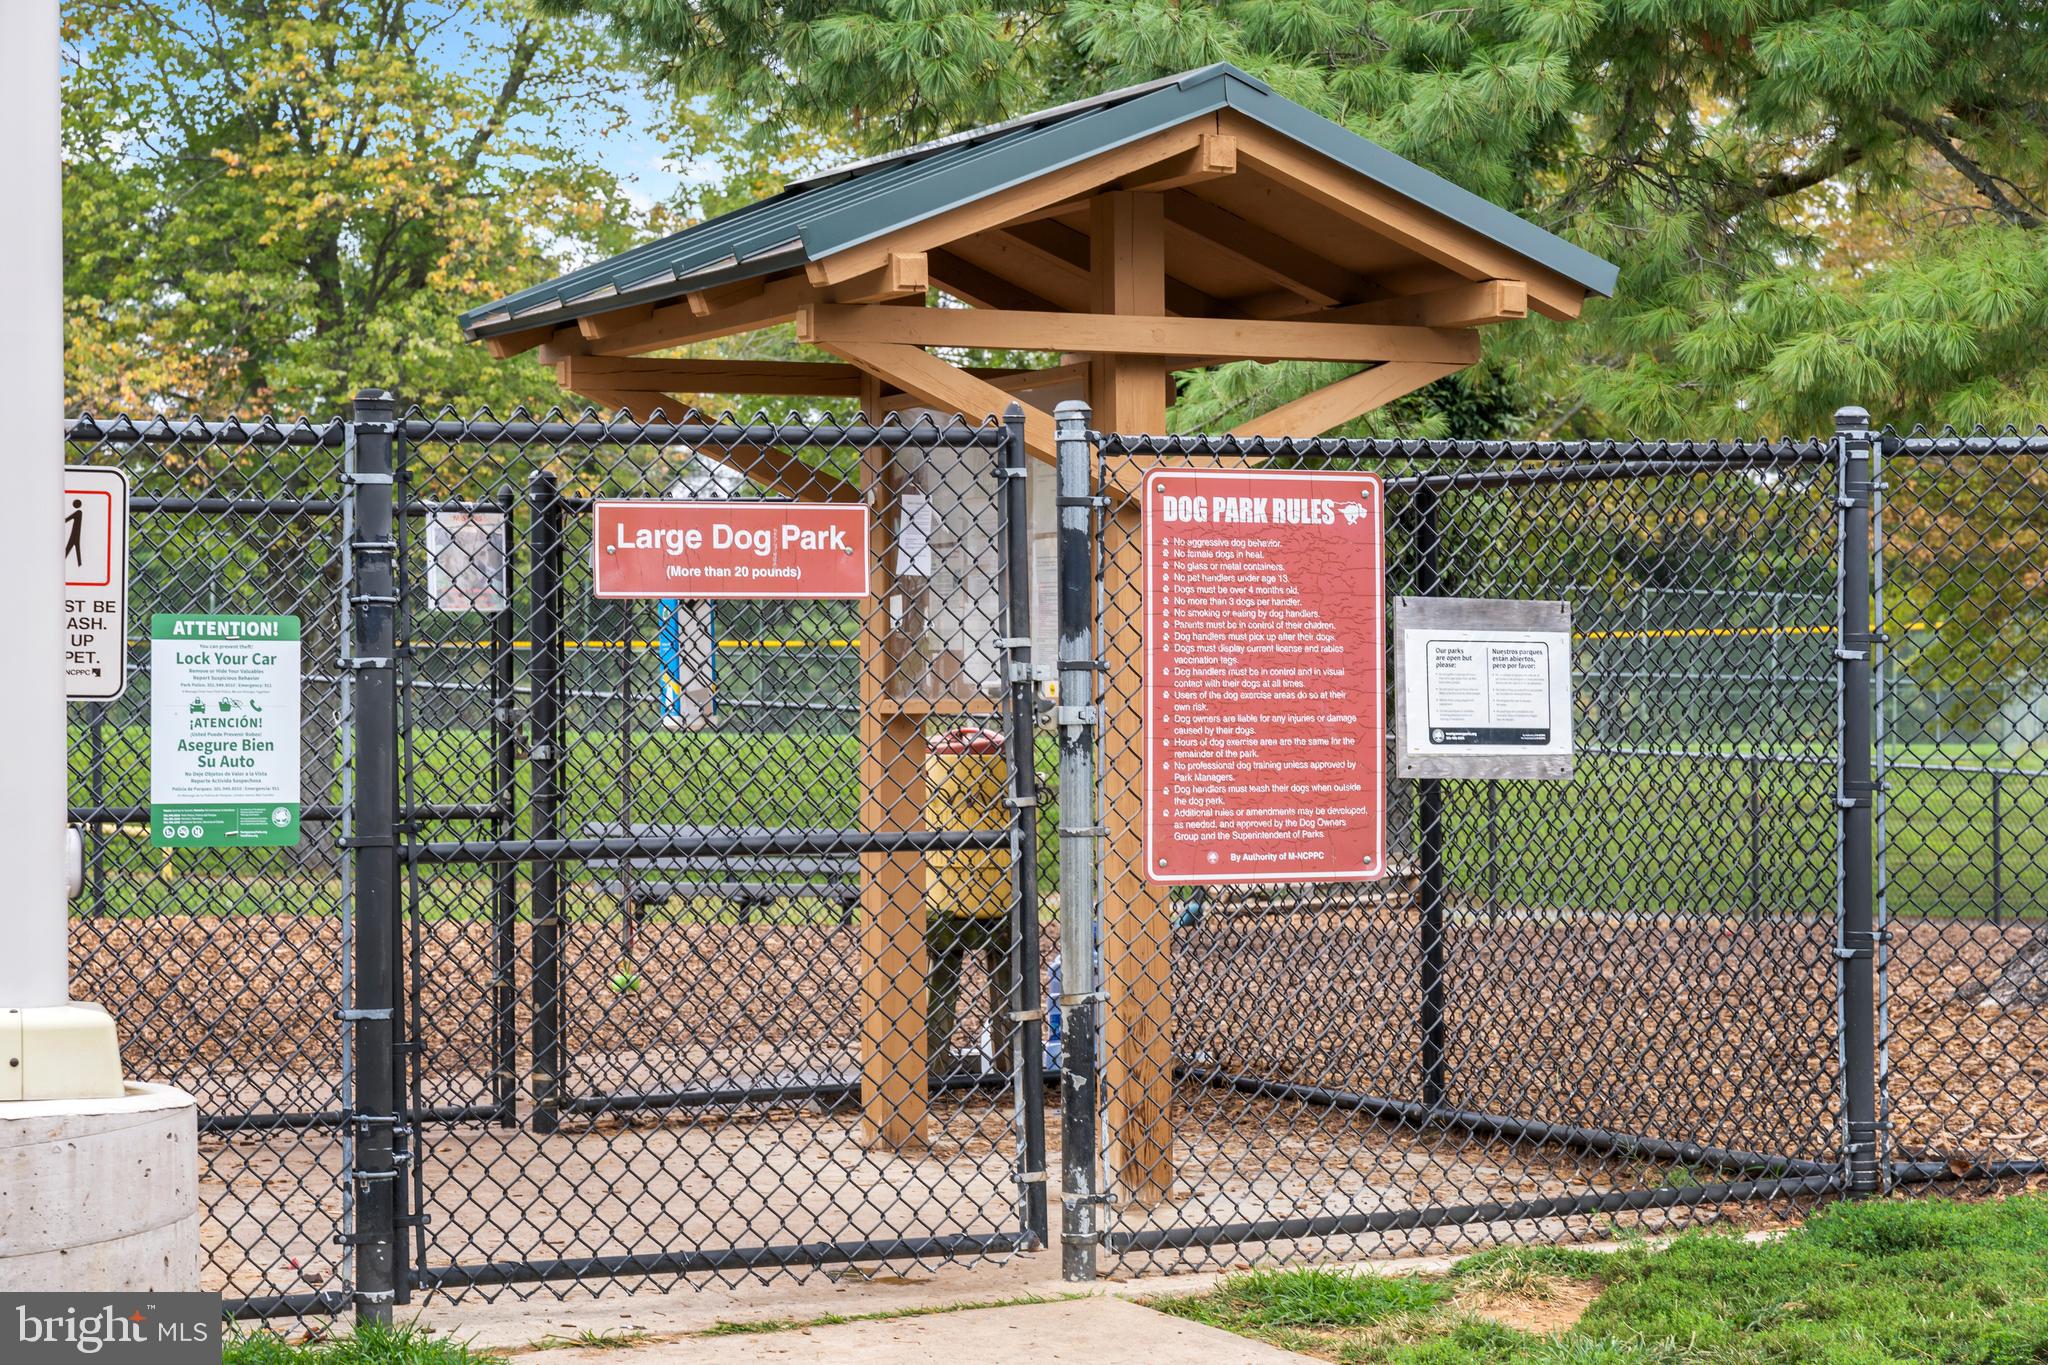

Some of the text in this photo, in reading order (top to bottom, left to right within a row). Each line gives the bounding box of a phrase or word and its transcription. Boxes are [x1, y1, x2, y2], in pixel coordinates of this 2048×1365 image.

[1163, 496, 1335, 524] DOG PARK RULES
[617, 523, 846, 556] Large Dog Park
[1174, 537, 1185, 547] No
[1188, 537, 1229, 548] aggressive
[1231, 537, 1246, 548] dog
[1174, 549, 1185, 558] No
[1188, 549, 1213, 558] female
[1216, 549, 1234, 560] dogs
[1237, 549, 1243, 558] in
[1174, 561, 1185, 570] No
[1188, 561, 1208, 572] glass
[1220, 561, 1241, 570] metal
[666, 566, 802, 580] (More than 20 pounds)
[1174, 573, 1185, 582] No
[1188, 573, 1200, 584] pet
[1202, 573, 1235, 582] handlers
[1238, 573, 1260, 582] under
[1262, 575, 1276, 584] age
[1174, 585, 1195, 596] Dogs
[1197, 585, 1216, 594] must
[1218, 585, 1228, 594] be
[1248, 585, 1253, 594] 4
[1256, 585, 1284, 594] months
[65, 600, 116, 613] ST BE
[1174, 596, 1185, 605] No
[1210, 596, 1226, 605] than
[1229, 596, 1234, 605] 3
[1236, 596, 1255, 607] dogs
[1257, 598, 1269, 607] per
[1174, 608, 1185, 618] No
[1188, 608, 1220, 619] smoking
[1258, 608, 1267, 619] by
[1269, 608, 1284, 619] dog
[173, 620, 278, 636] ATTENTION!
[1174, 620, 1204, 629] Parents
[1206, 620, 1225, 629] must
[1227, 620, 1237, 629] be
[1239, 620, 1246, 629] in
[1248, 620, 1274, 629] control
[1276, 620, 1284, 629] of
[1286, 620, 1302, 629] their
[72, 634, 94, 646] UP
[1174, 632, 1190, 643] Dog
[1193, 632, 1226, 641] handlers
[1228, 632, 1247, 641] must
[1249, 632, 1264, 643] pick
[1267, 634, 1276, 643] up
[1278, 632, 1296, 641] after
[1297, 632, 1313, 641] their
[176, 652, 277, 665] Lock Your Car
[1174, 679, 1202, 687] contact
[1204, 679, 1220, 687] with
[1223, 679, 1239, 687] their
[1242, 679, 1260, 689] dogs
[1262, 679, 1270, 687] at
[1272, 679, 1281, 687] all
[190, 715, 262, 730] ¡ATENCIÓN!
[1174, 726, 1202, 735] caused
[1205, 726, 1214, 736] by
[1216, 726, 1233, 735] their
[178, 738, 274, 754] Asegure Bien
[1174, 749, 1214, 758] remainder
[1216, 749, 1223, 758] of
[1225, 749, 1237, 758] the
[198, 755, 255, 768] Su Auto
[1174, 772, 1192, 781] Park
[1174, 796, 1186, 805] the
[1189, 796, 1203, 807] dog
[1231, 852, 1241, 861] By
[1243, 852, 1276, 861] Authority
